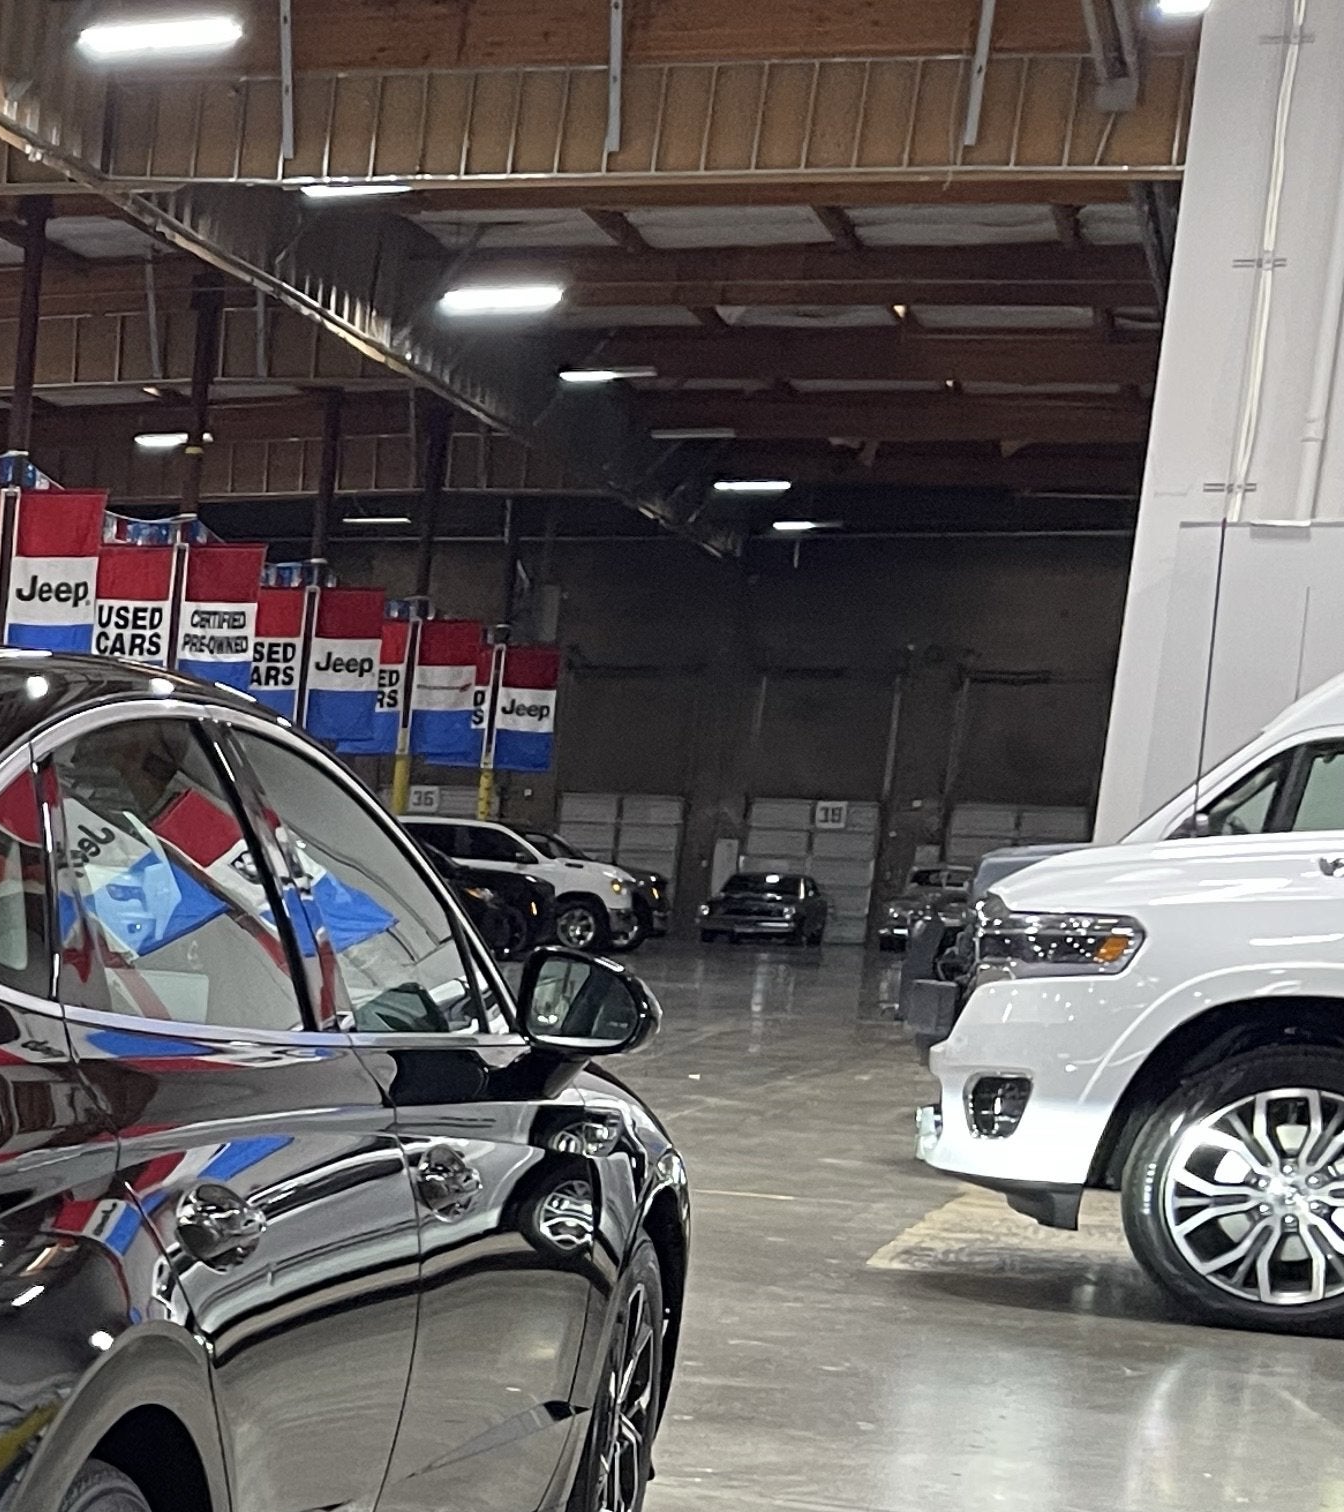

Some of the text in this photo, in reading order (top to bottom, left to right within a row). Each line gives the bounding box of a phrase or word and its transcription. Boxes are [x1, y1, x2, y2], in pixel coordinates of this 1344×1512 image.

[15, 575, 89, 608] Jeep
[98, 605, 162, 630] USED
[95, 631, 161, 656] CARS
[253, 642, 296, 663] SED
[250, 666, 294, 686] ARS
[315, 651, 373, 678] Jeep
[501, 698, 550, 721] Jeep
